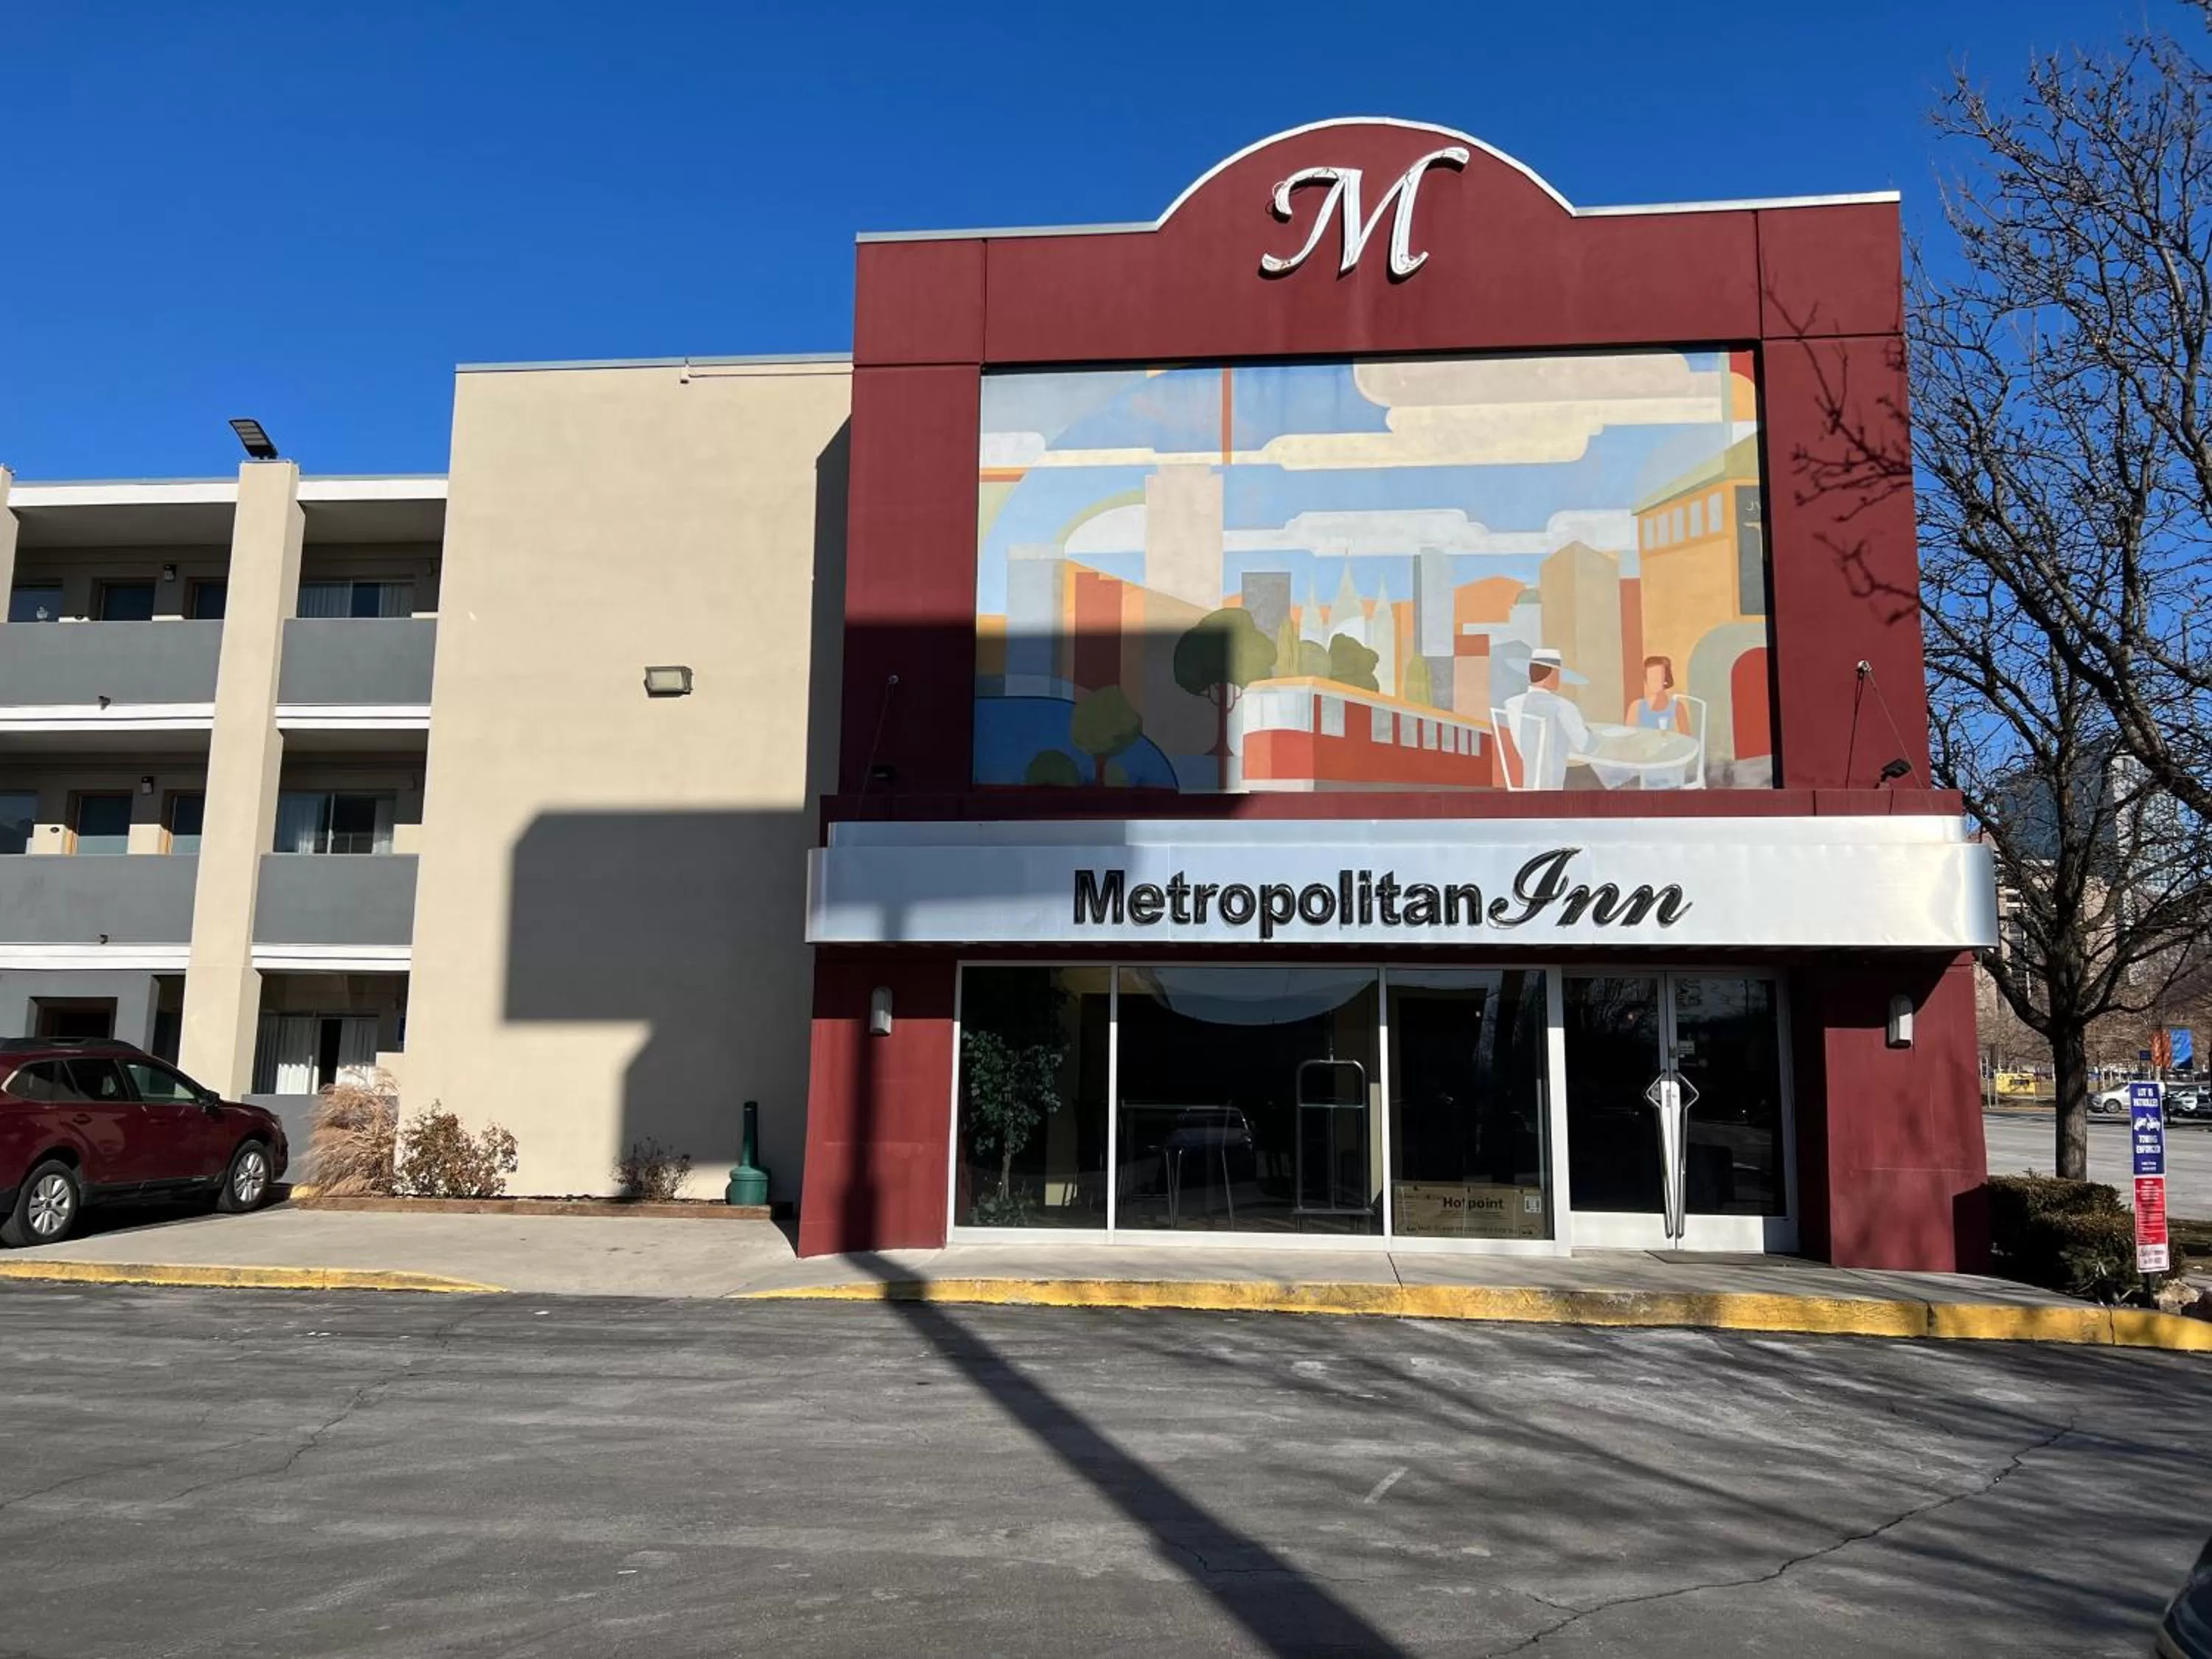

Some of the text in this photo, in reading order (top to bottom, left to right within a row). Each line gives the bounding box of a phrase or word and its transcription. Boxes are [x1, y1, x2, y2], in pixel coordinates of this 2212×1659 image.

[1259, 147, 1470, 282] M
[1073, 847, 1693, 941] Metropolitan Inn
